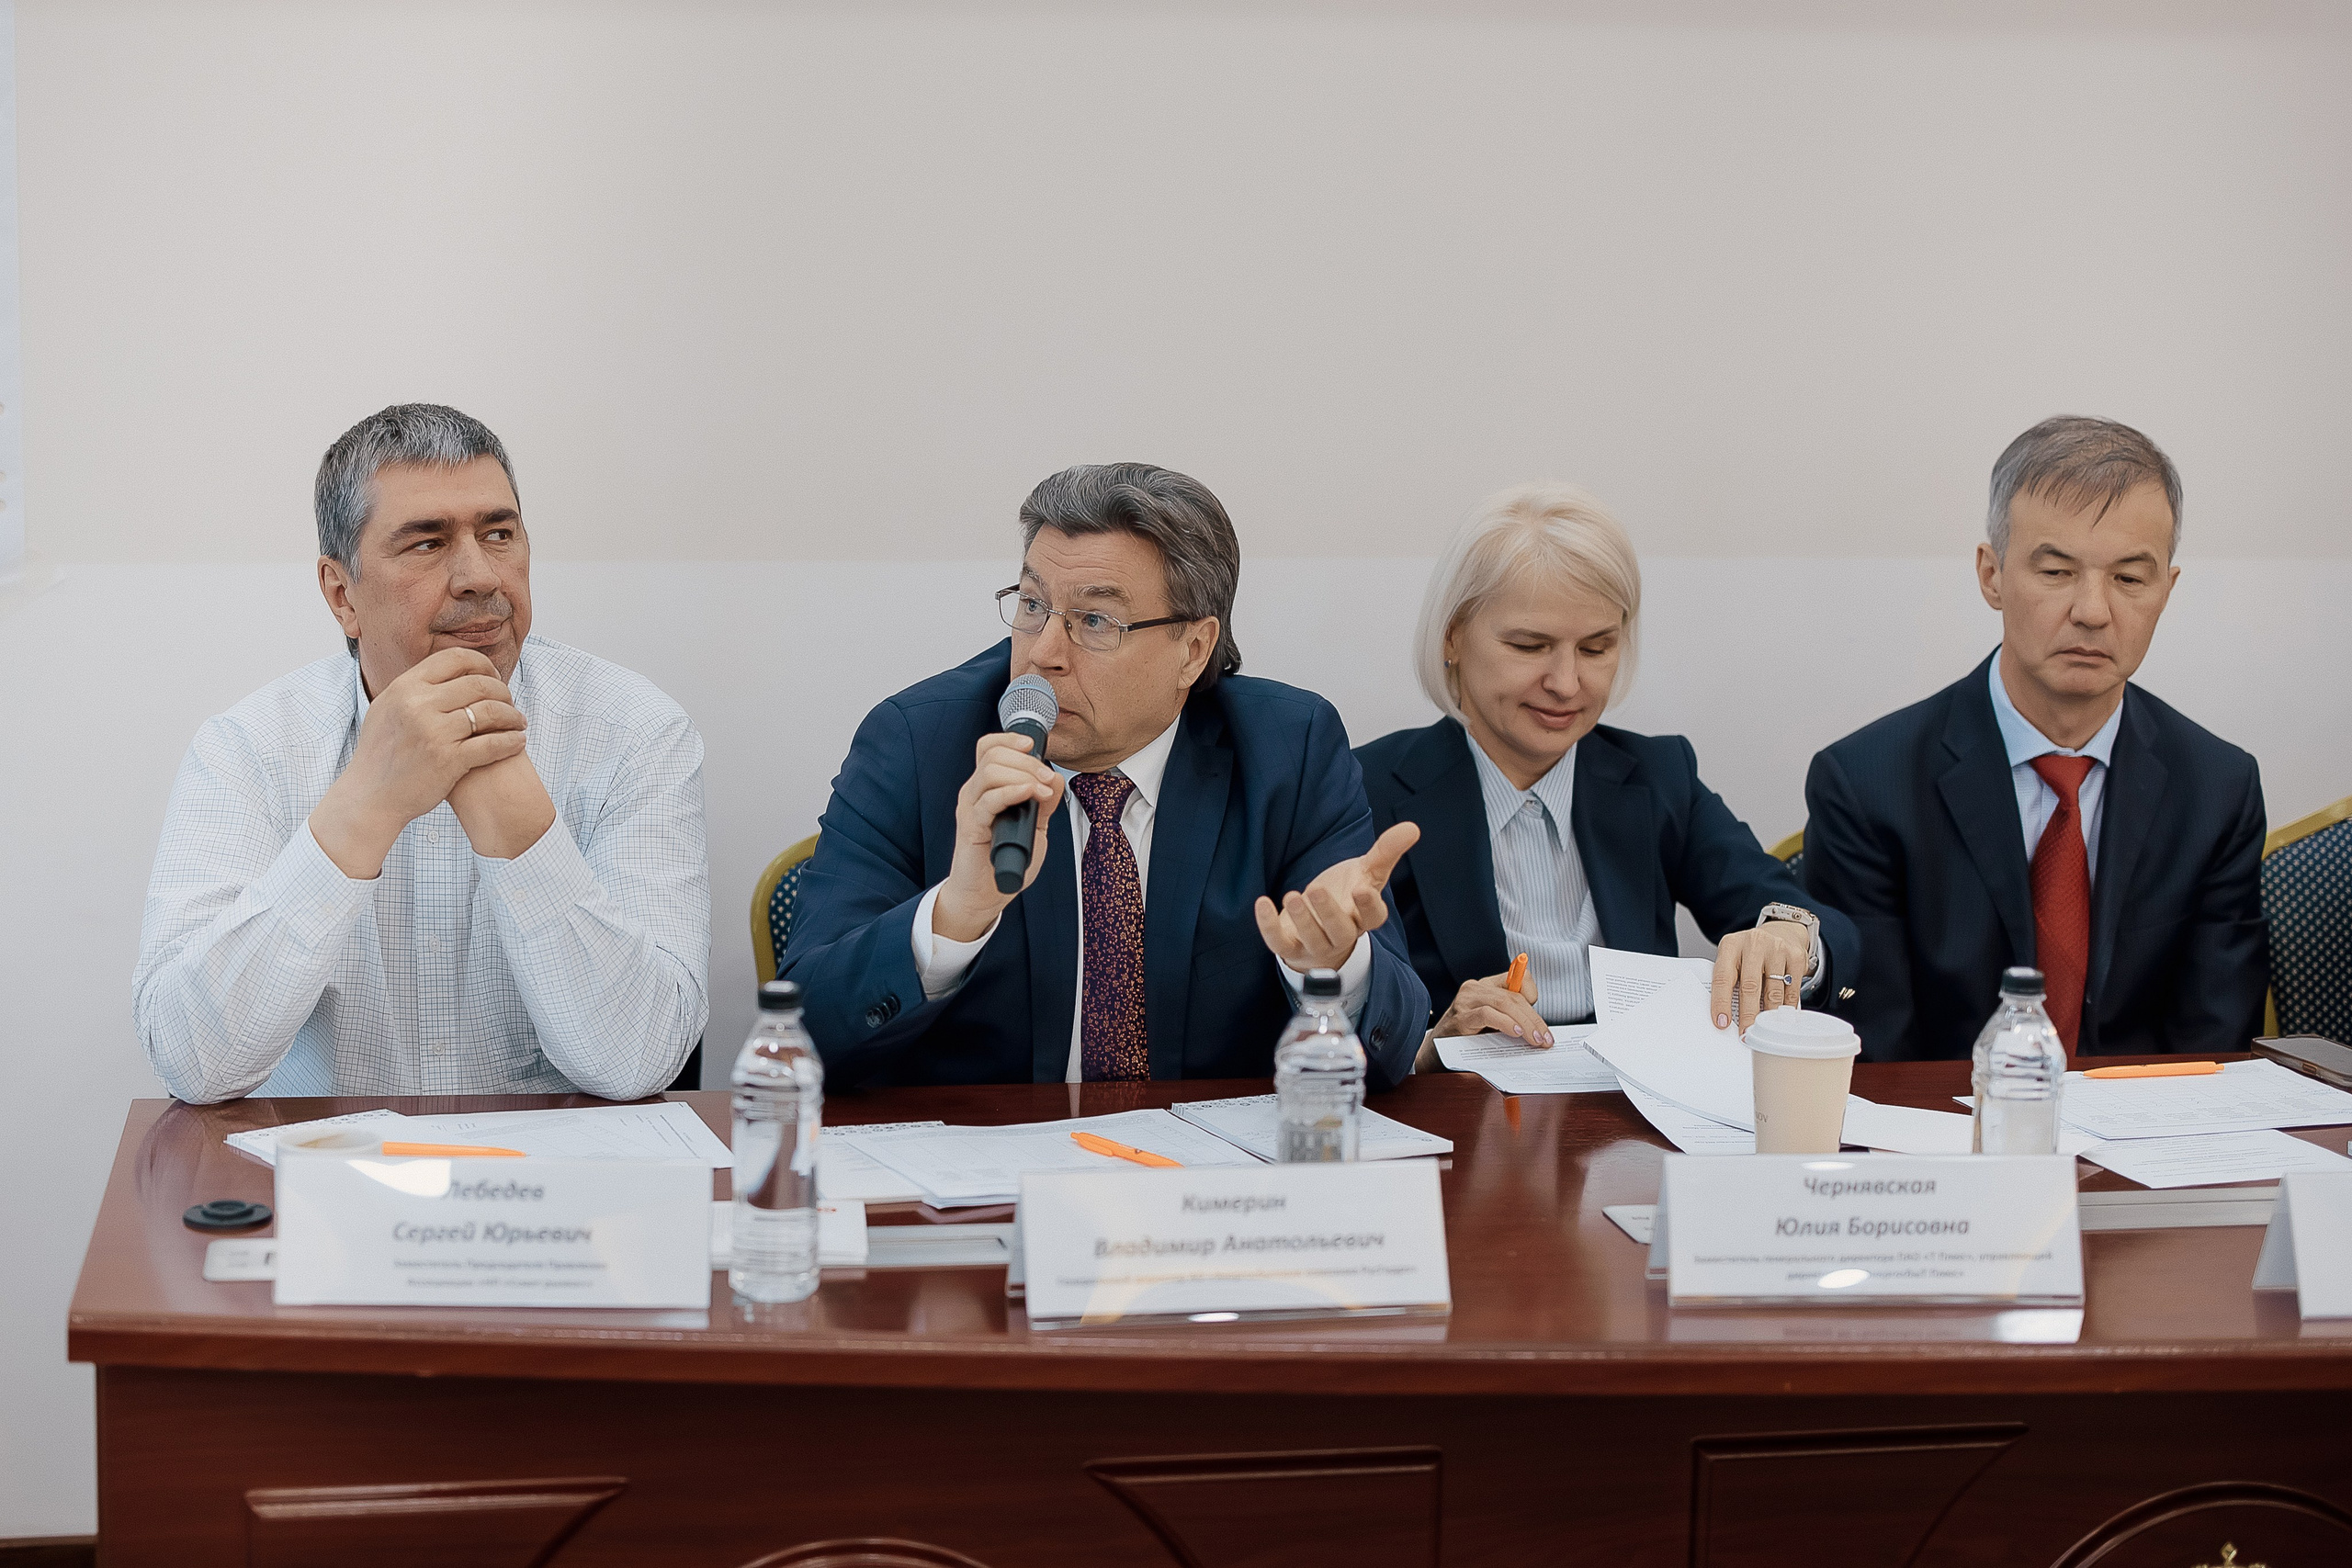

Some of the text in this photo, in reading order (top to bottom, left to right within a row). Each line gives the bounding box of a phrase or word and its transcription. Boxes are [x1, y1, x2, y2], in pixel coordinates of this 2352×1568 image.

[446, 1180, 545, 1201] Лебедев
[1803, 1177, 1937, 1200] Чернявская
[1181, 1194, 1286, 1215] Кимерин
[391, 1222, 593, 1245] Сергей Юрьевич
[1775, 1216, 1970, 1239] Юлия Борисовна
[1093, 1233, 1385, 1258] Владимир Анатольевич
